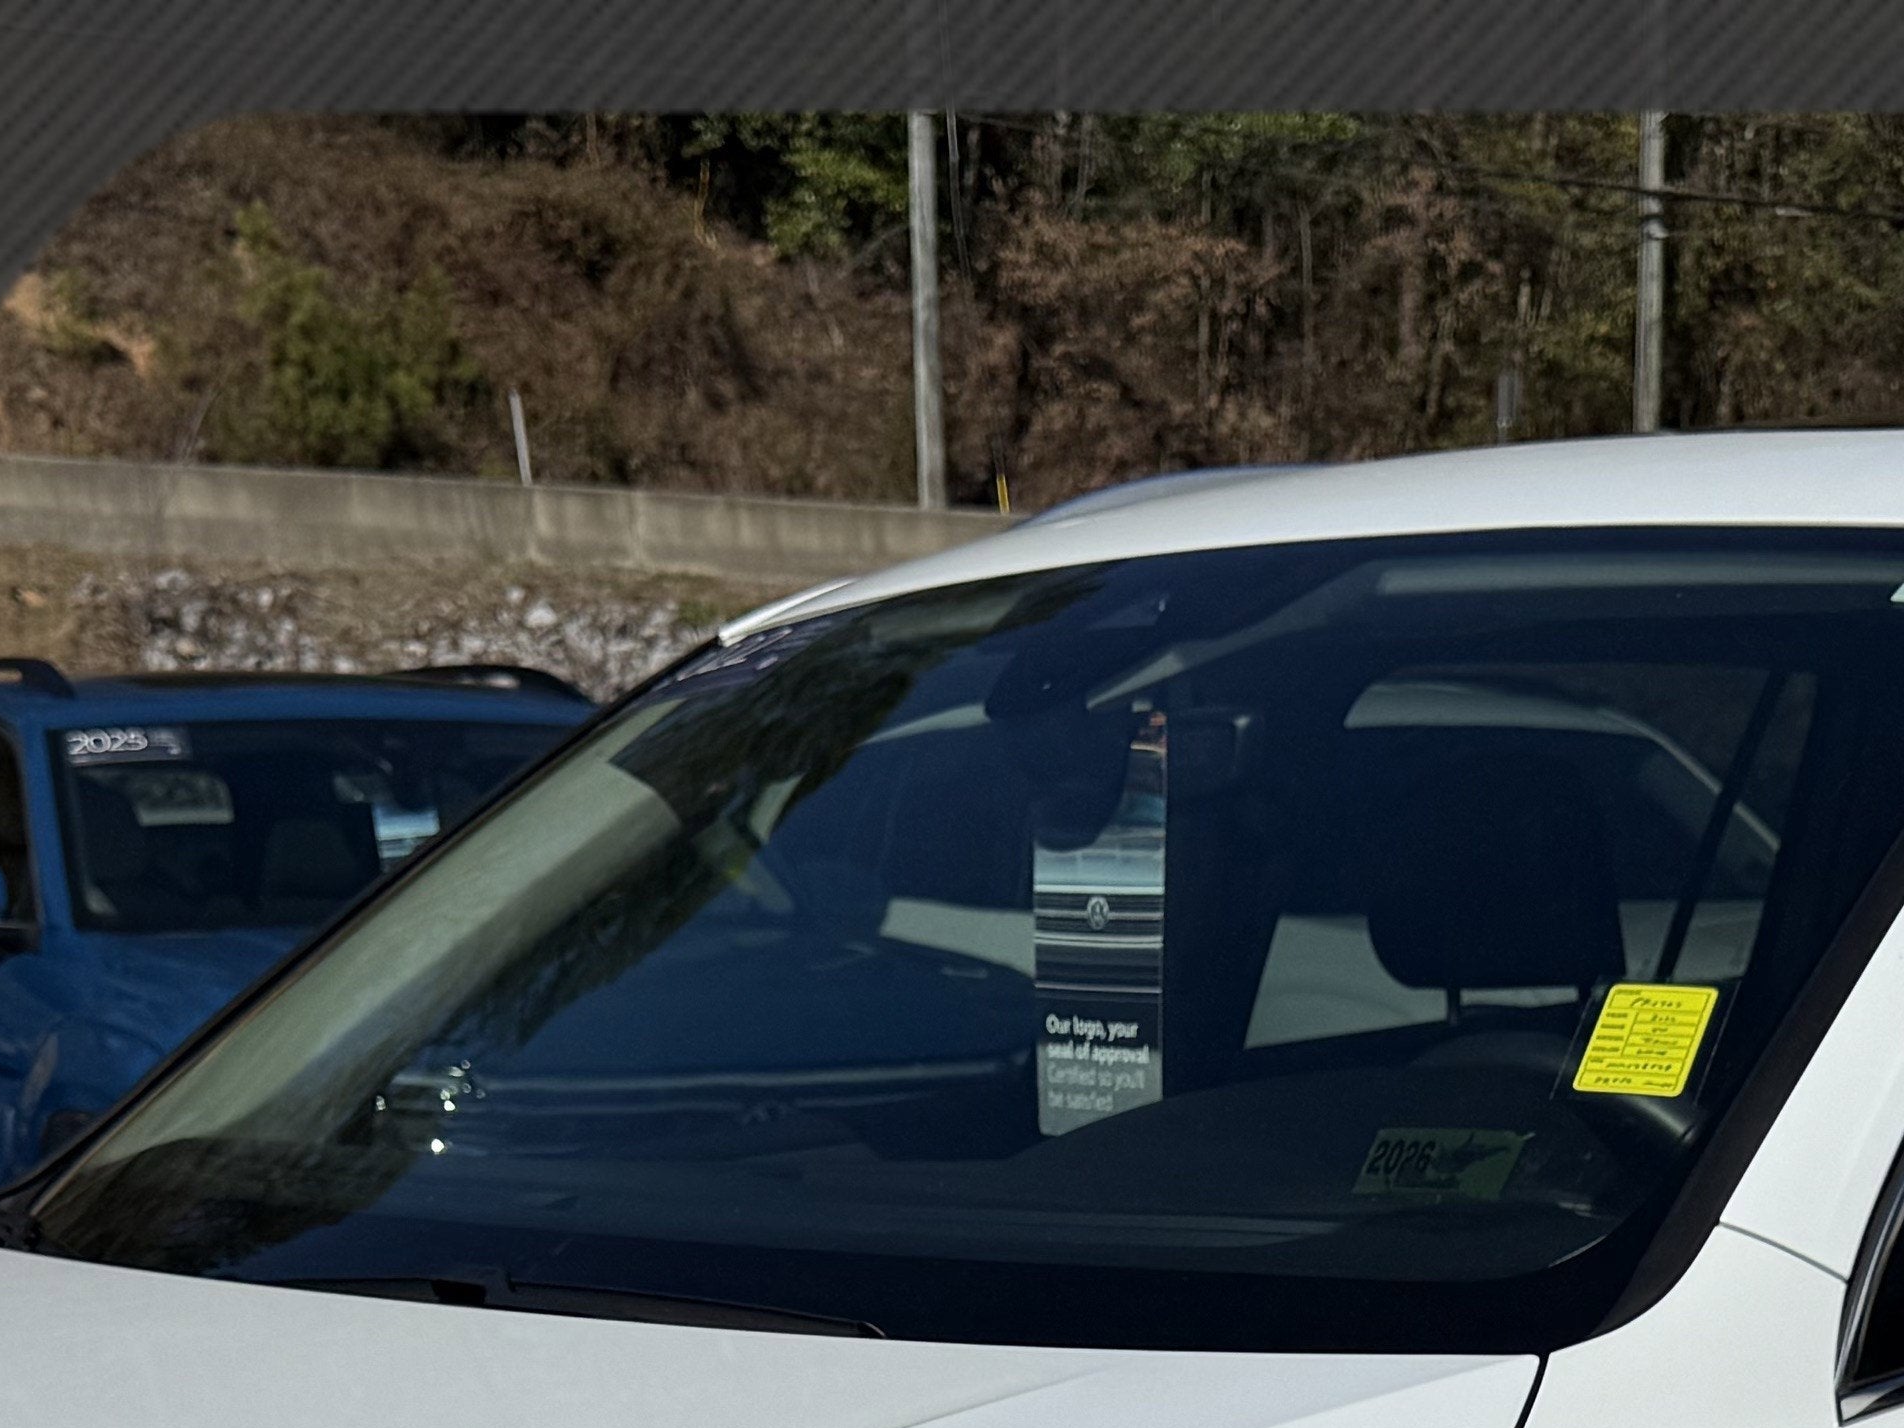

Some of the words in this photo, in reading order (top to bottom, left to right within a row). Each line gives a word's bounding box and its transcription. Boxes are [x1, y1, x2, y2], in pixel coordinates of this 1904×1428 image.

[67, 728, 148, 755] 2025
[1045, 1013, 1071, 1034] Our
[1072, 1013, 1107, 1041] logo,
[1107, 1021, 1139, 1042] your
[1091, 1044, 1150, 1067] approval
[1366, 1140, 1436, 1175] 2026
